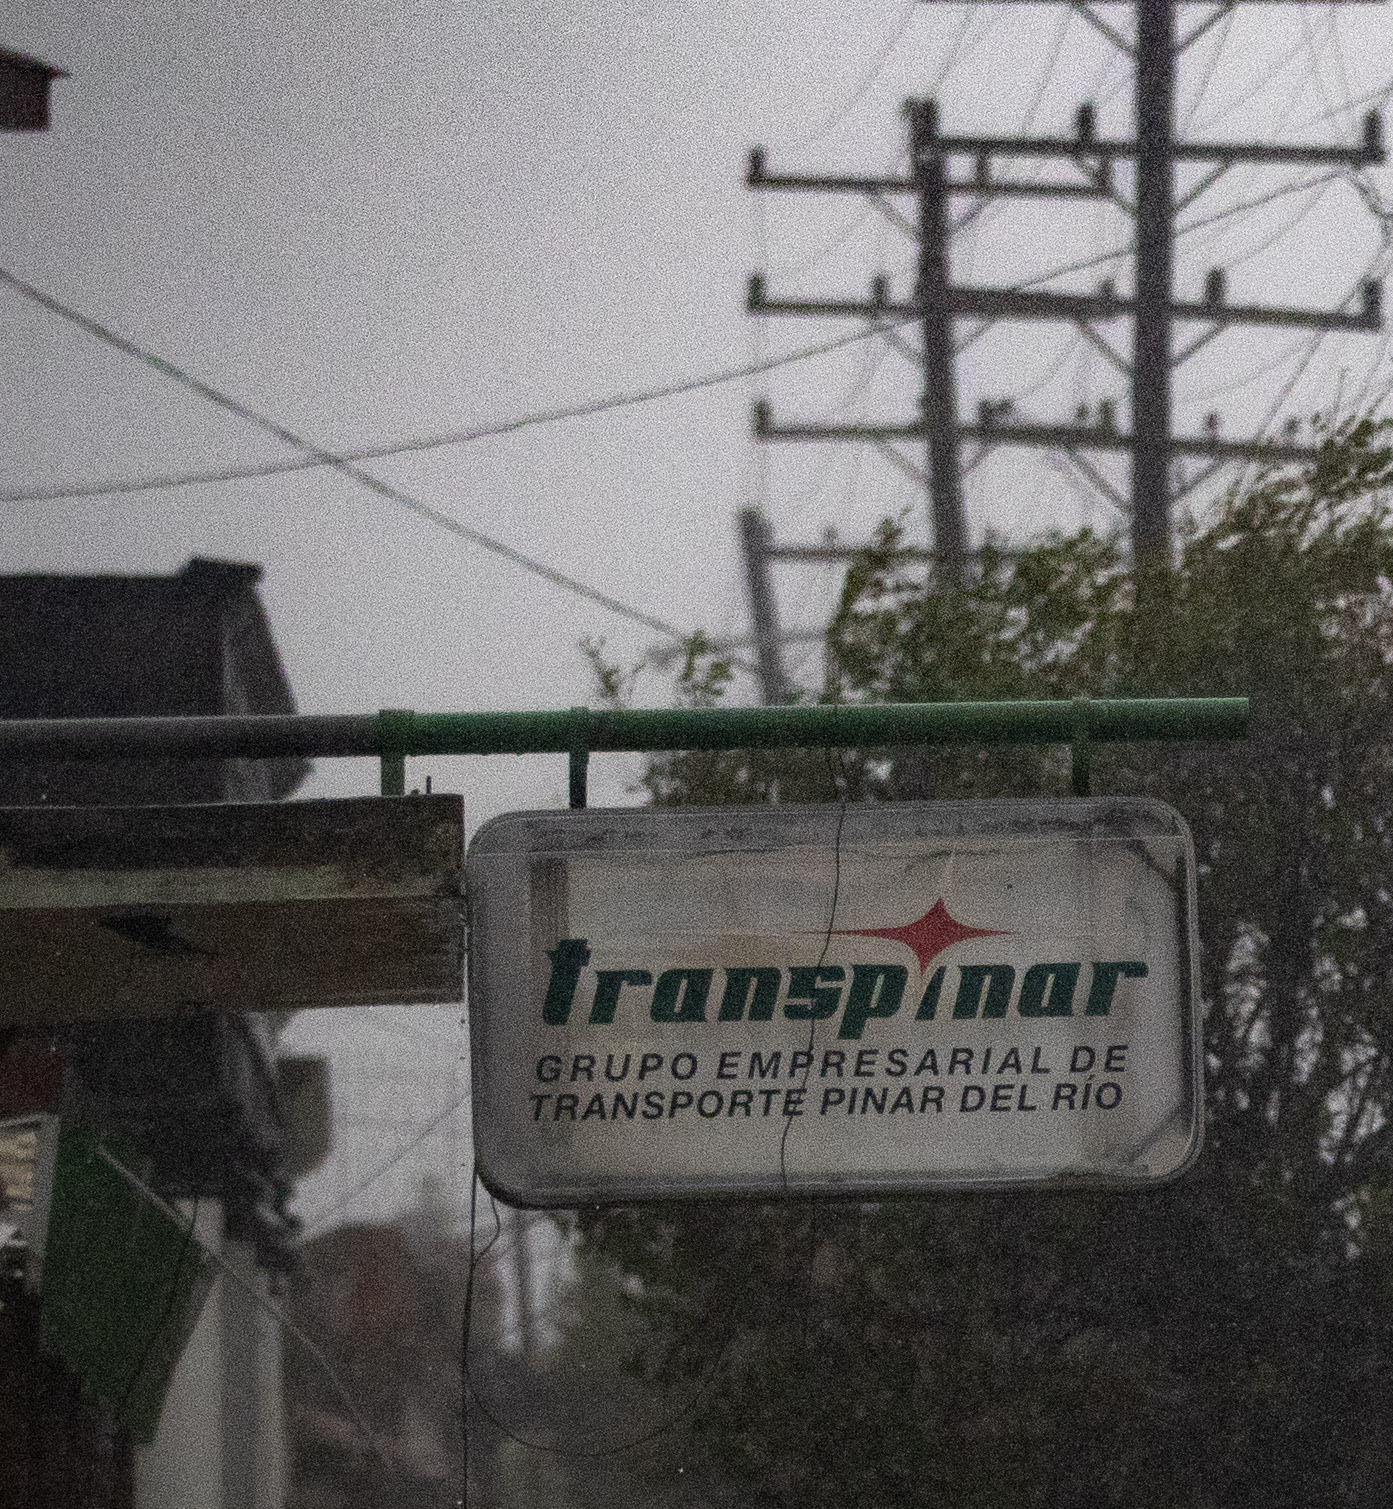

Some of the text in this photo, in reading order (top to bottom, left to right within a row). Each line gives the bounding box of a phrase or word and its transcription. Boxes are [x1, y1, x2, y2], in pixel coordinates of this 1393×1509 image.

[543, 938, 1148, 1040] transpinar
[536, 1045, 1129, 1082] GRUPO EMPRESARIAL DE
[531, 1075, 1123, 1121] TRANSPORTE PINAR DEL RÍO
